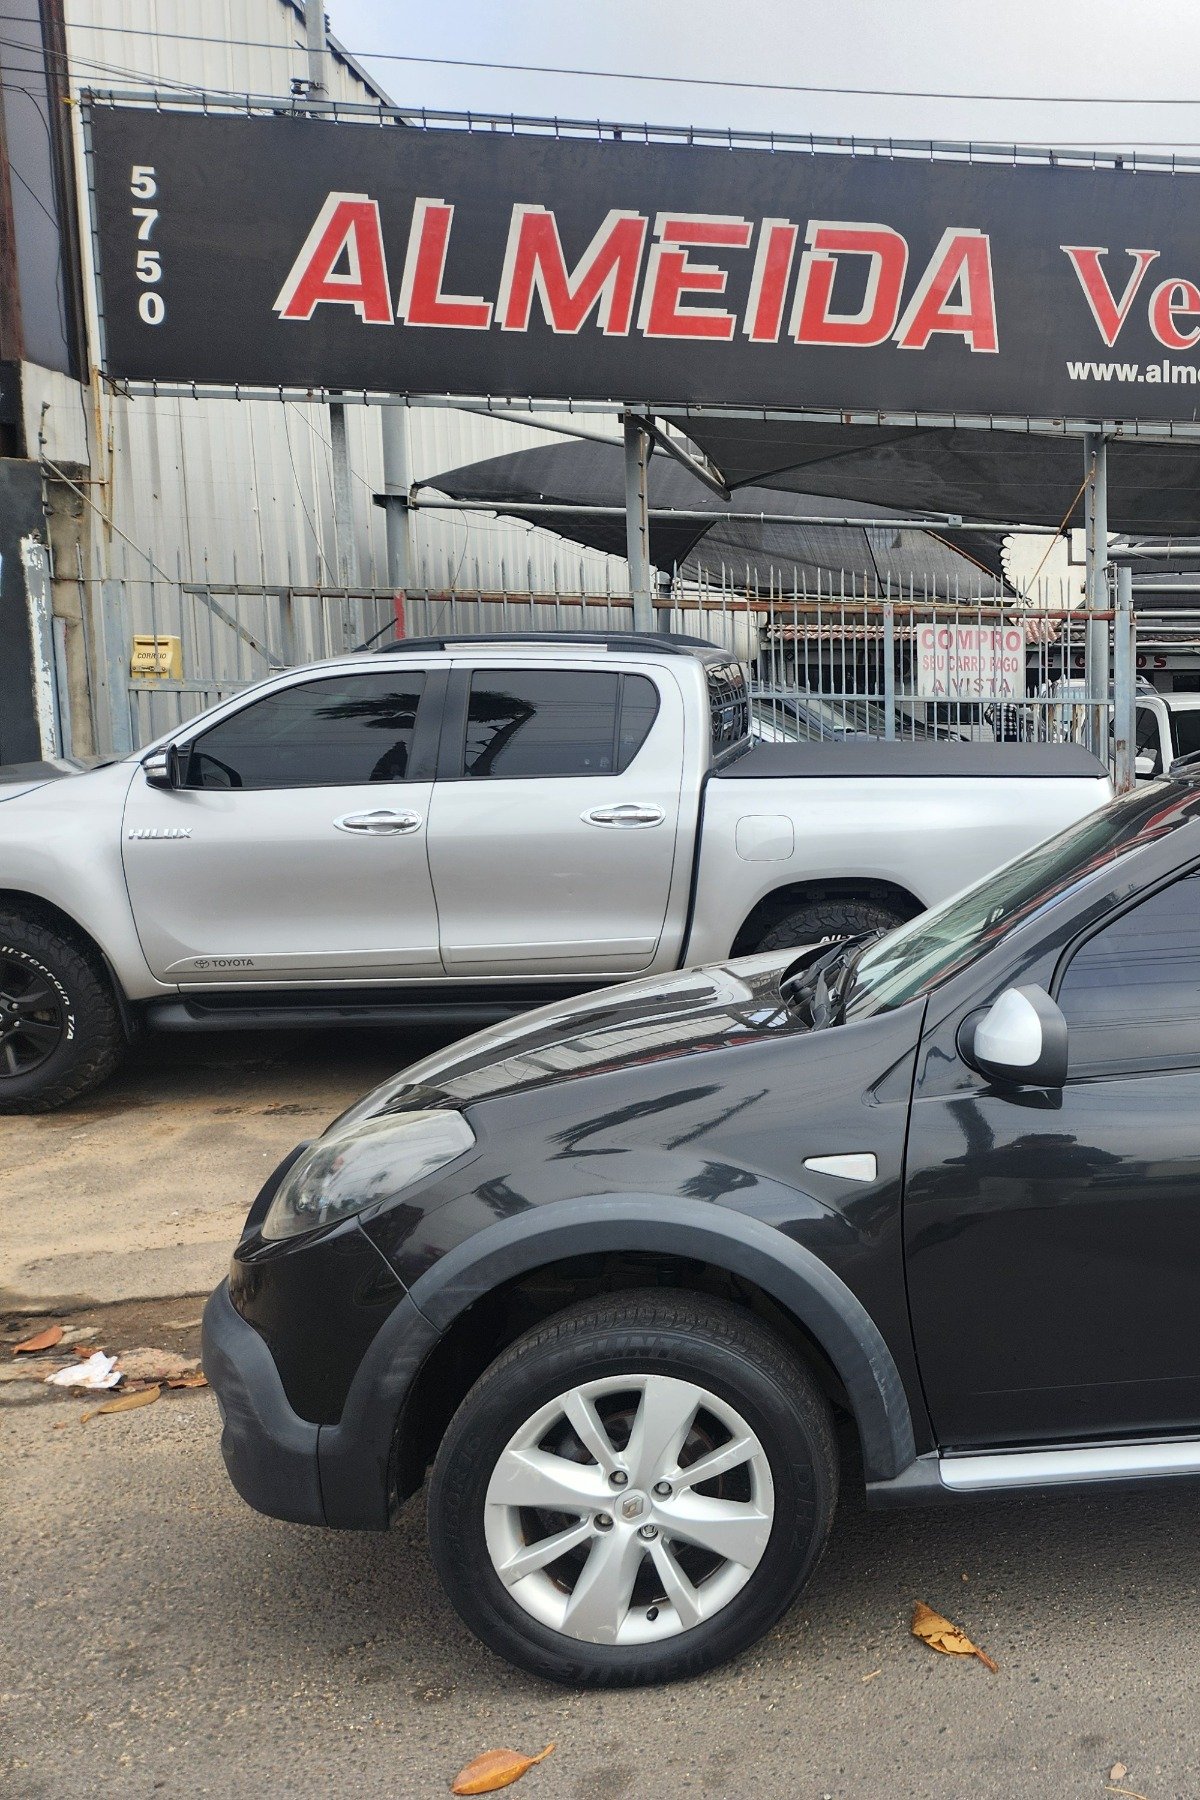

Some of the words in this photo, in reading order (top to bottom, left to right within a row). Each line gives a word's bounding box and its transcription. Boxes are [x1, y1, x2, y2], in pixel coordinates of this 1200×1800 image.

[130, 165, 165, 325] 5750
[271, 191, 1000, 354] ALMEIDA
[921, 628, 1021, 652] COMPRO
[922, 655, 944, 671] SEU
[948, 656, 985, 672] CARRO
[990, 657, 1019, 673] PAGO
[952, 678, 1011, 693] VISTA
[128, 828, 193, 839] HILUX
[212, 958, 254, 967] TOYOTA
[0, 946, 70, 1005] ll-Terrain
[66, 1014, 75, 1040] T/A
